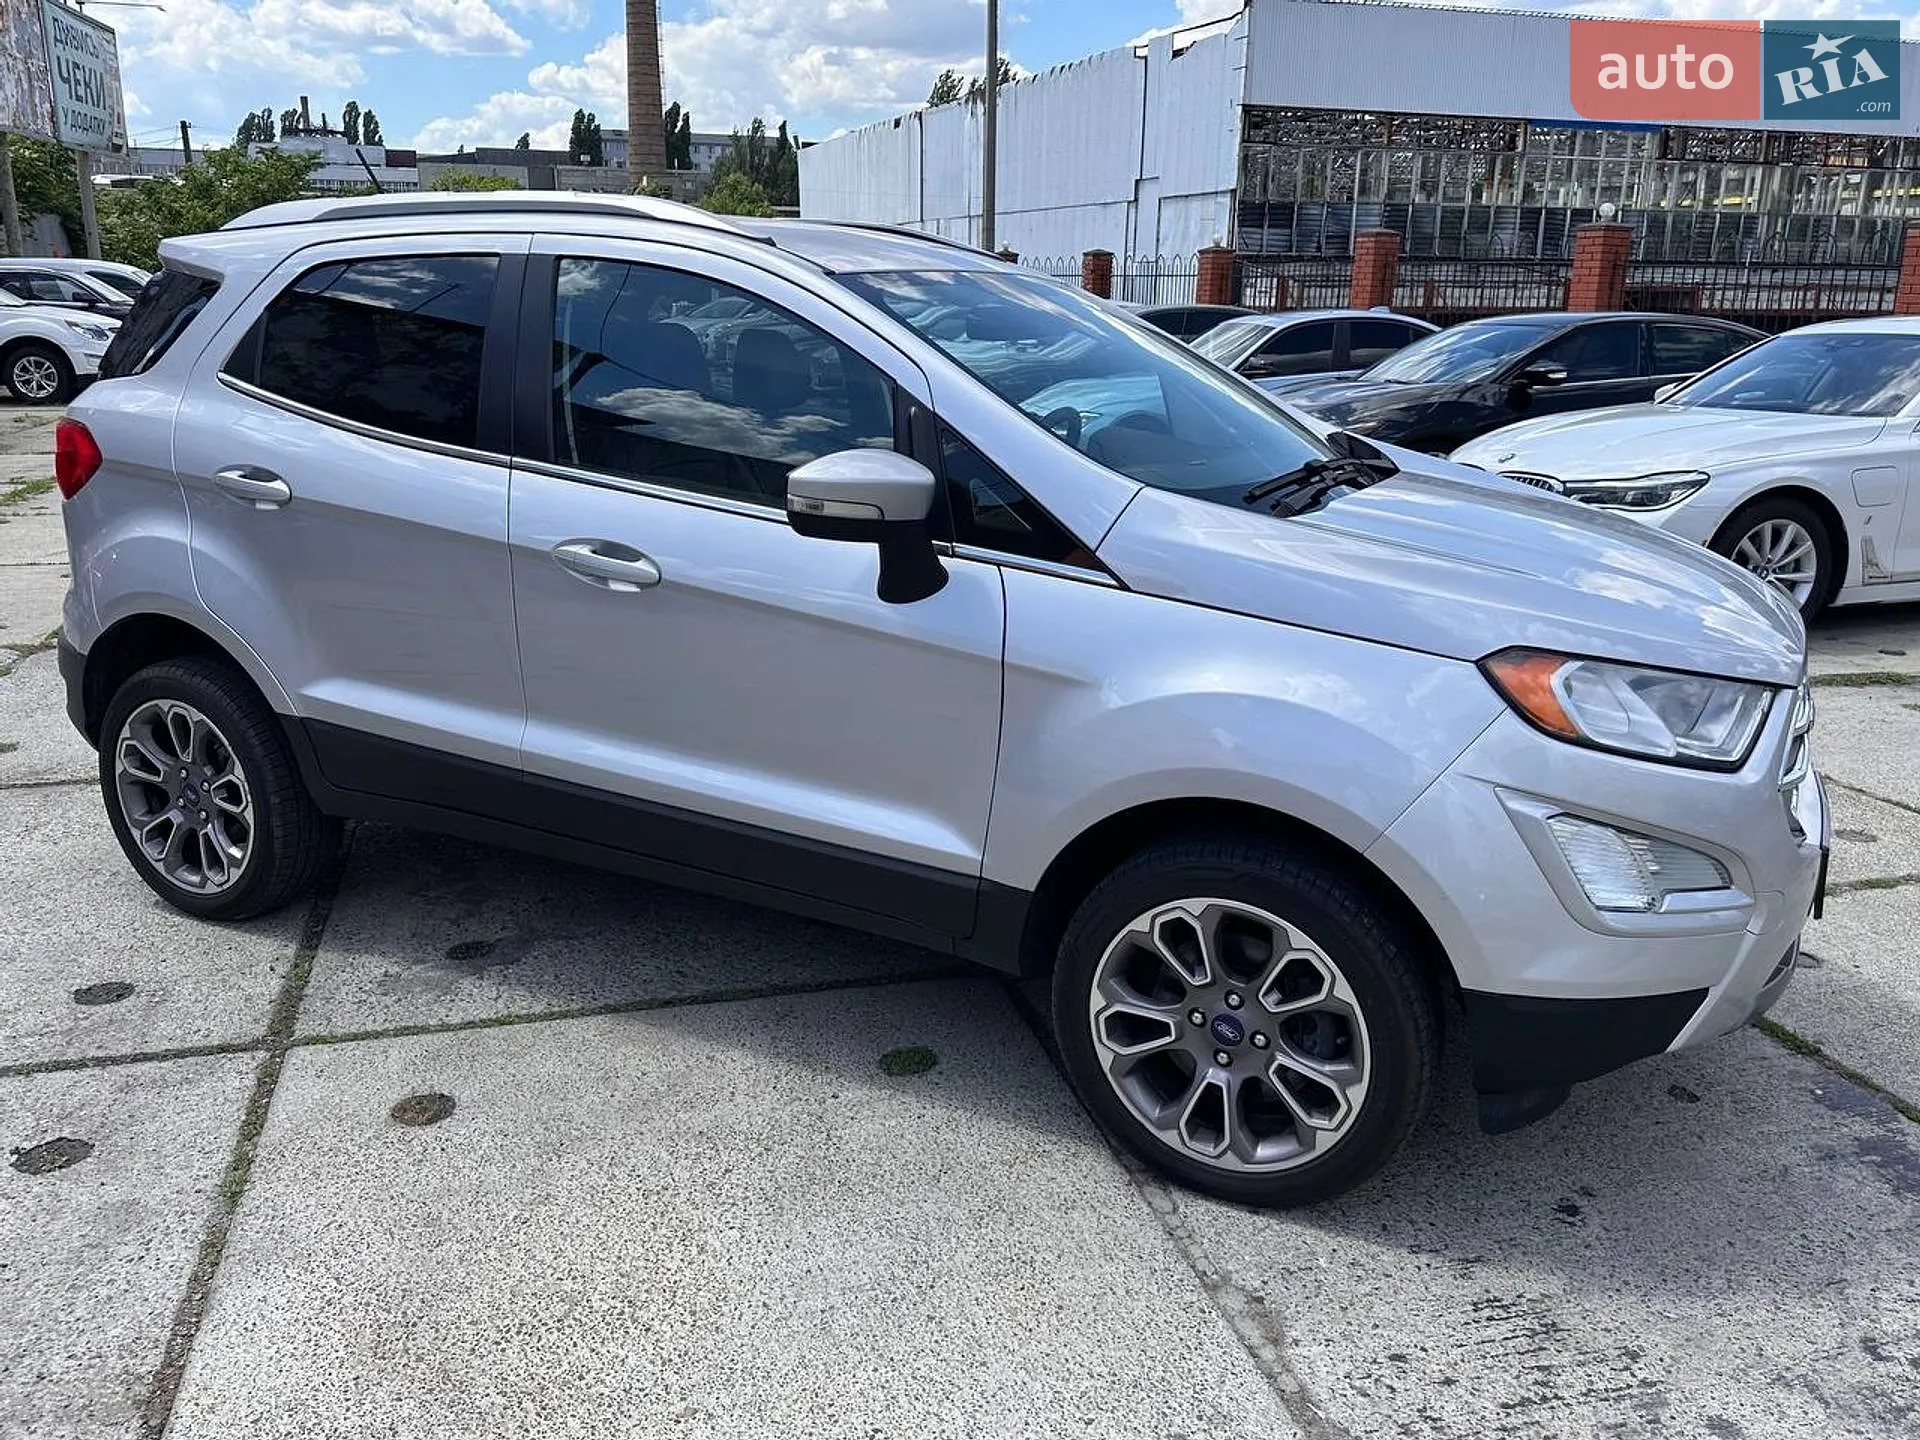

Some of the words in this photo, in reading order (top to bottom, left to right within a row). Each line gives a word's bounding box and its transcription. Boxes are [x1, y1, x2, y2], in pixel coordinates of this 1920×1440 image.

[52, 16, 99, 59] ДИВИСЬ
[57, 56, 106, 110] ЧЕКИ
[70, 109, 106, 136] ДОДАТКУ
